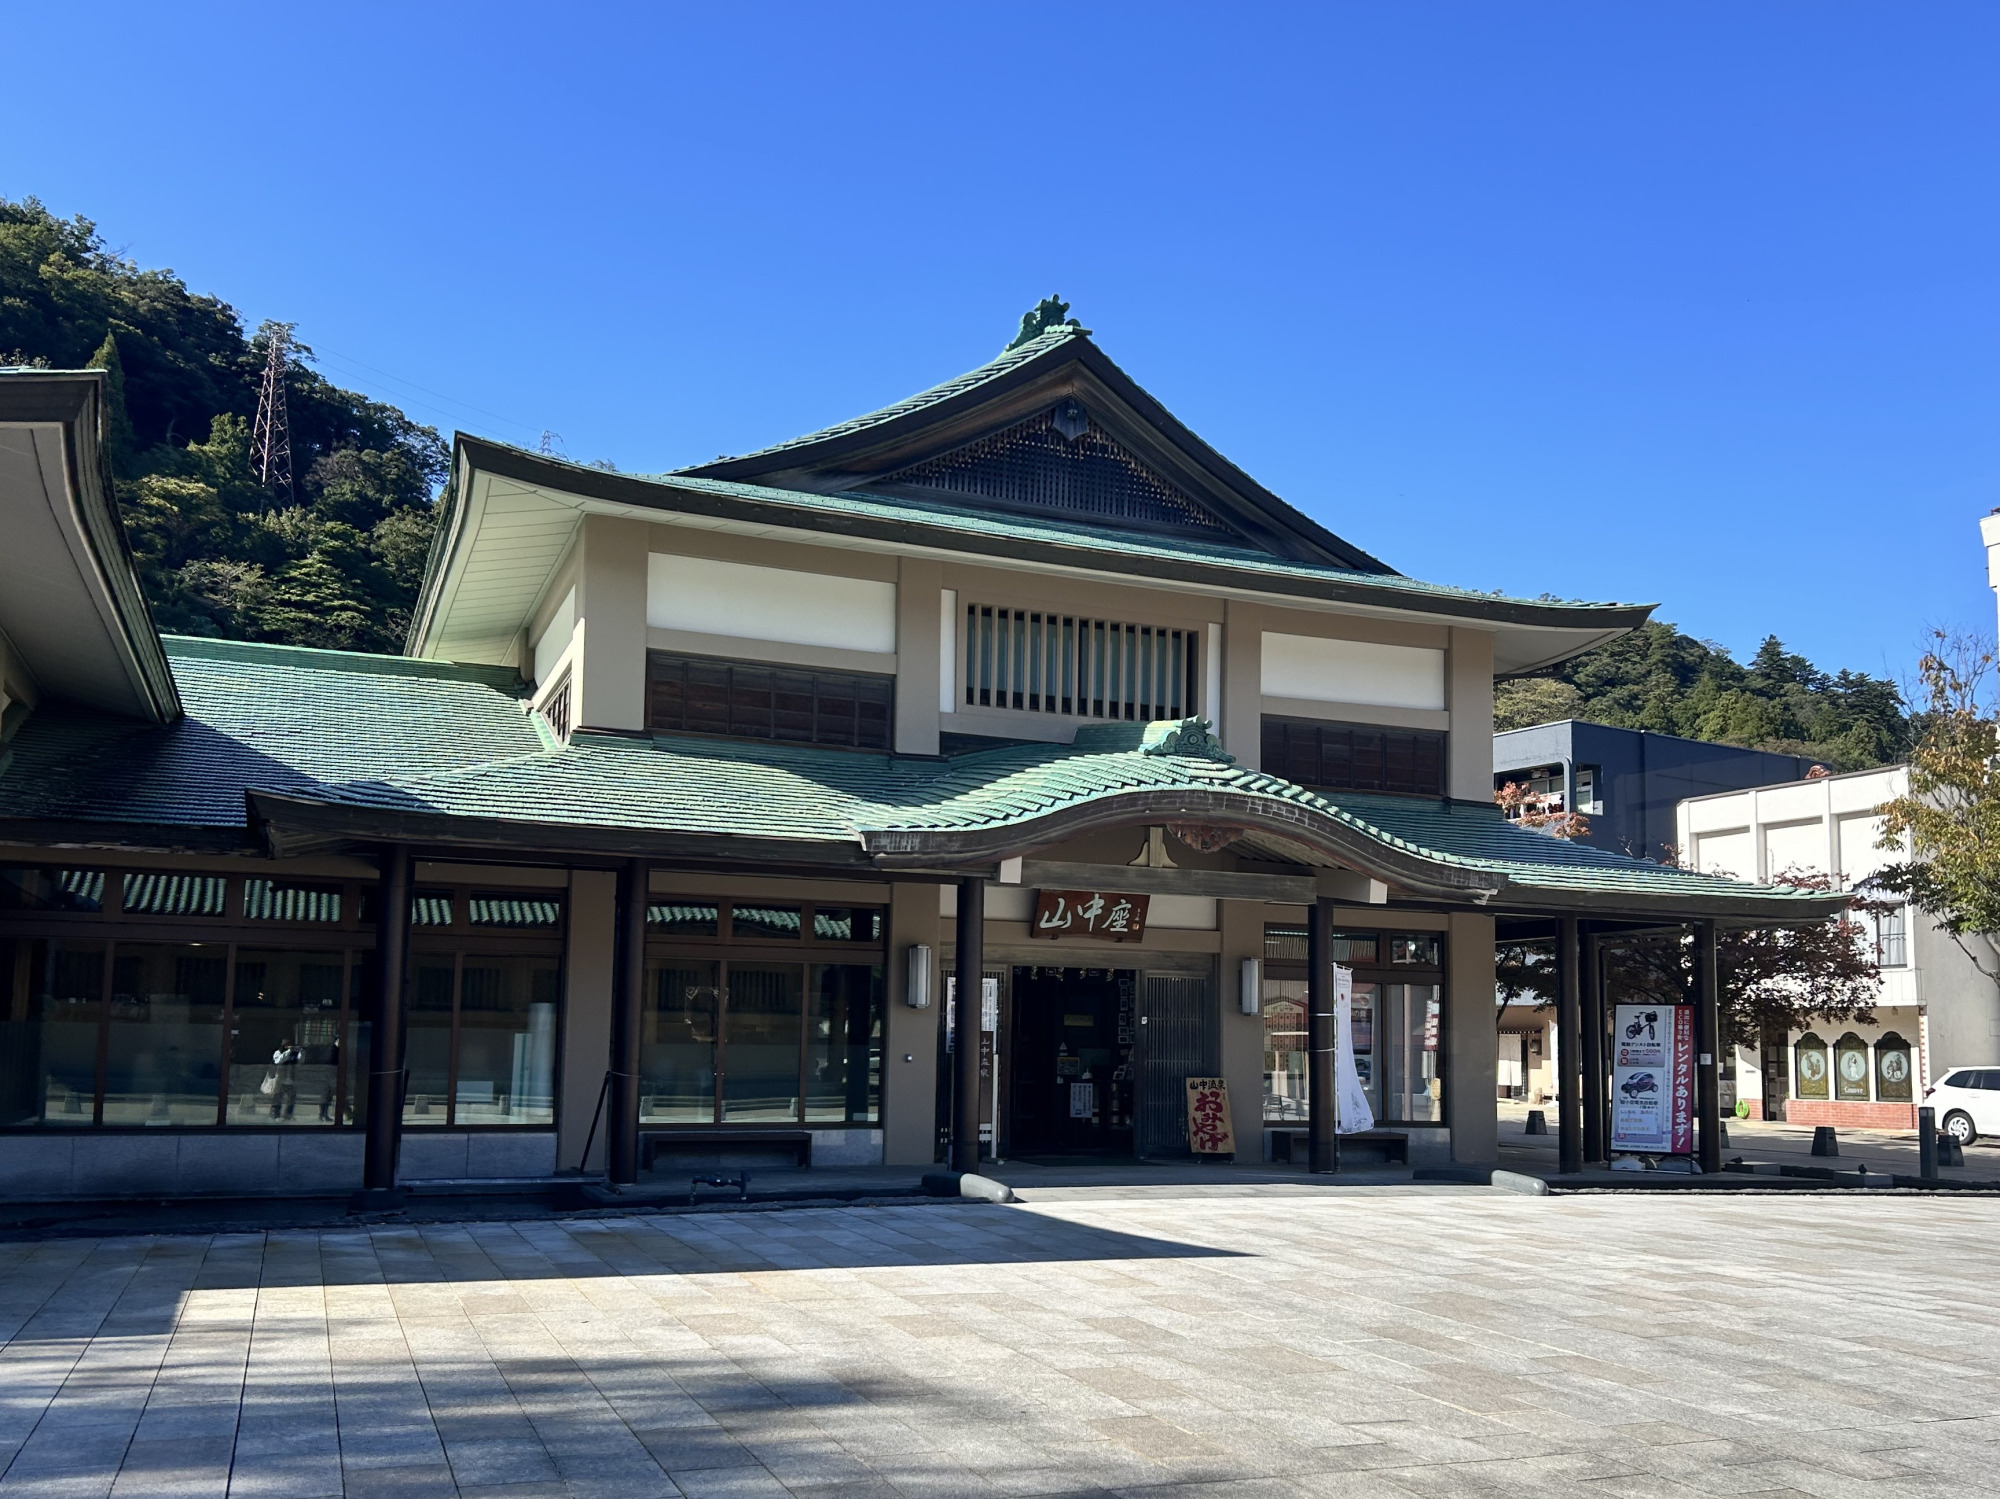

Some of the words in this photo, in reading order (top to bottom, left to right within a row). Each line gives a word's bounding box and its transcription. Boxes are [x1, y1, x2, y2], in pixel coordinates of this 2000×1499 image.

[1039, 893, 1132, 932] 山中座
[1189, 1079, 1226, 1091] 山中温泉
[1192, 1090, 1229, 1152] おみやげ
